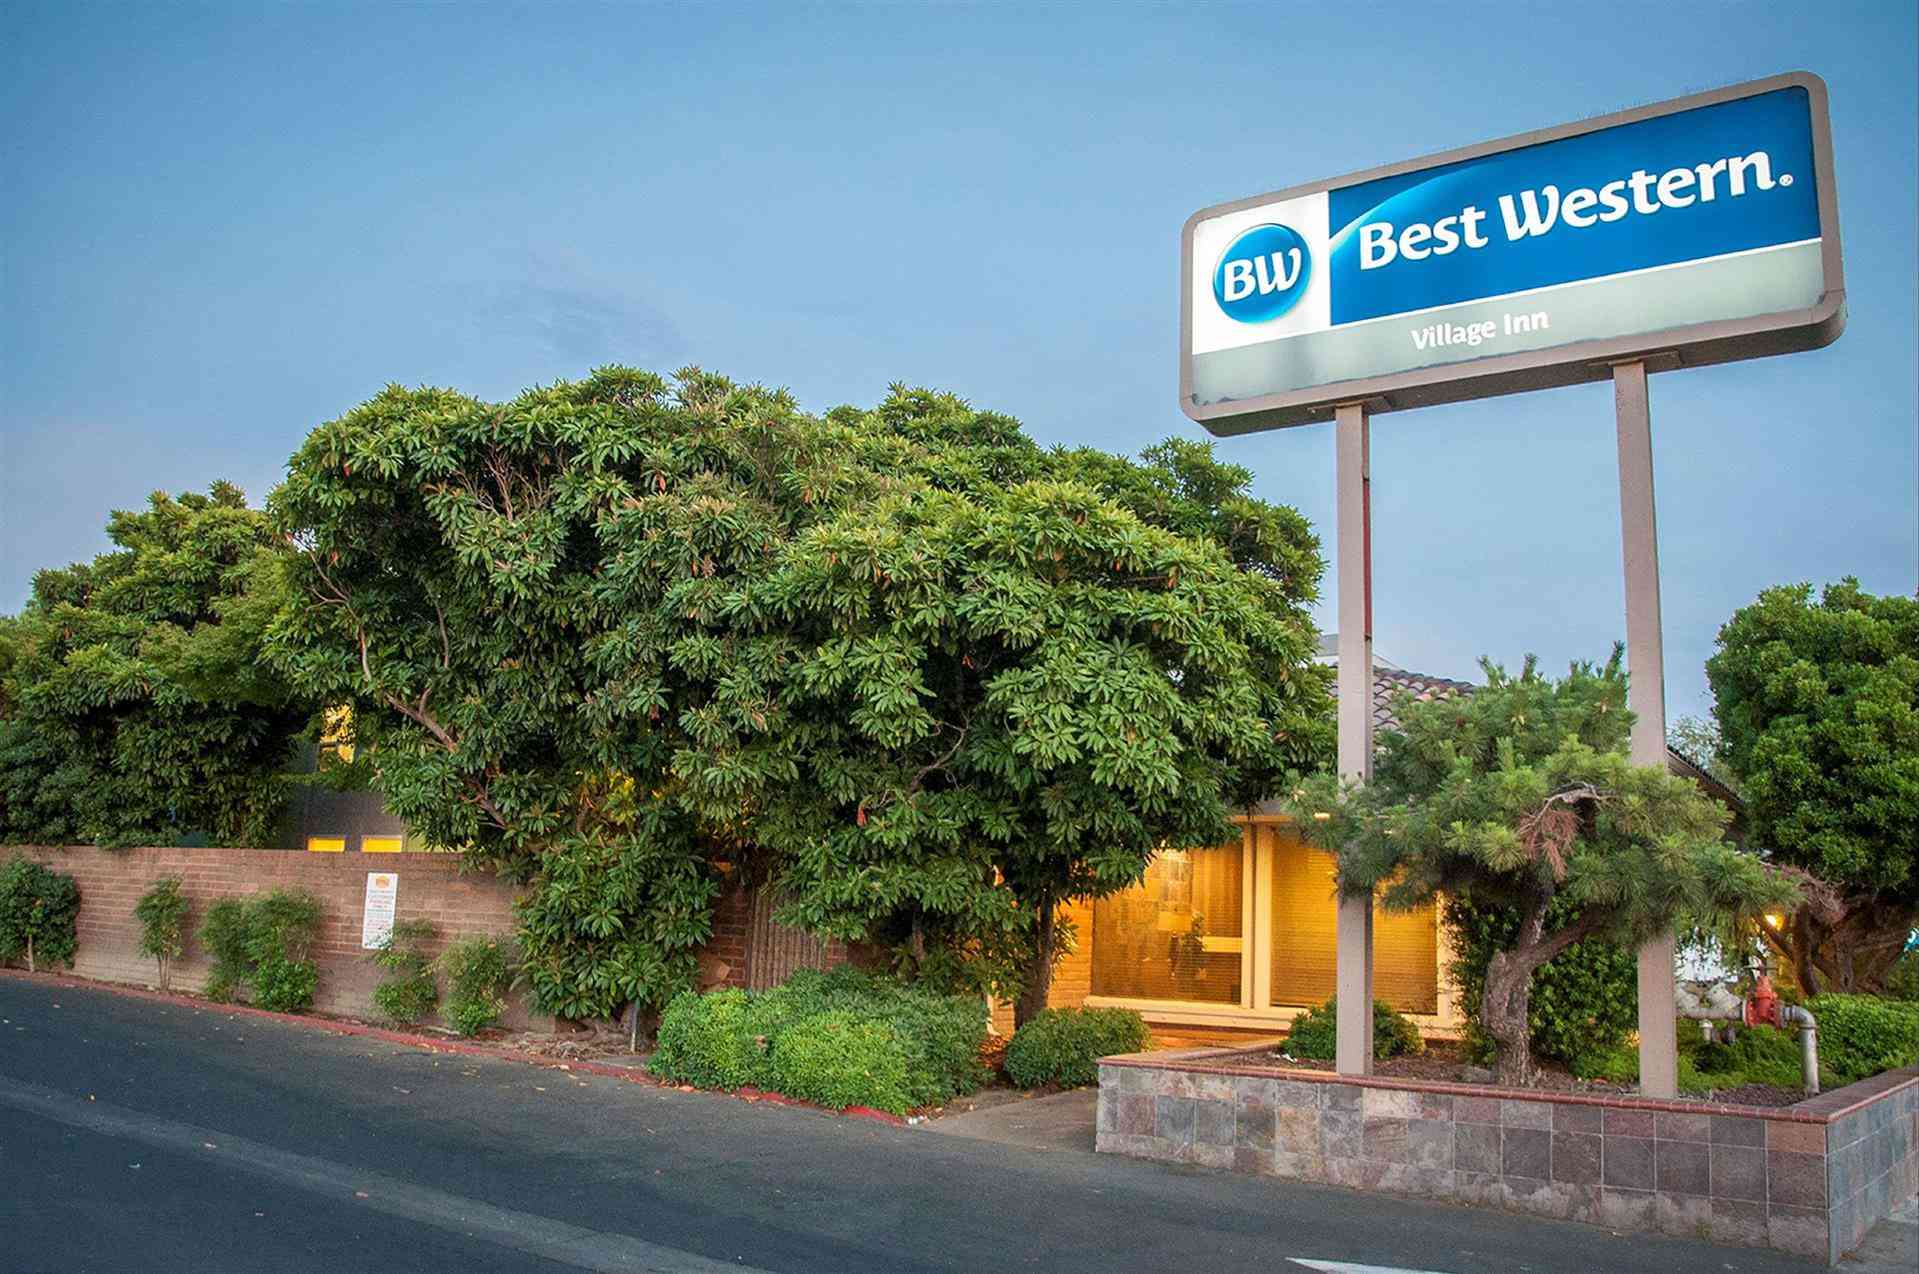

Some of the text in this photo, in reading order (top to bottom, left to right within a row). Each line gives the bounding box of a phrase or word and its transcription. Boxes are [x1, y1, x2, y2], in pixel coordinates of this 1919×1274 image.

[1359, 206, 1489, 271] Best
[1224, 247, 1302, 303] BW
[1410, 311, 1550, 350] Village Inn
